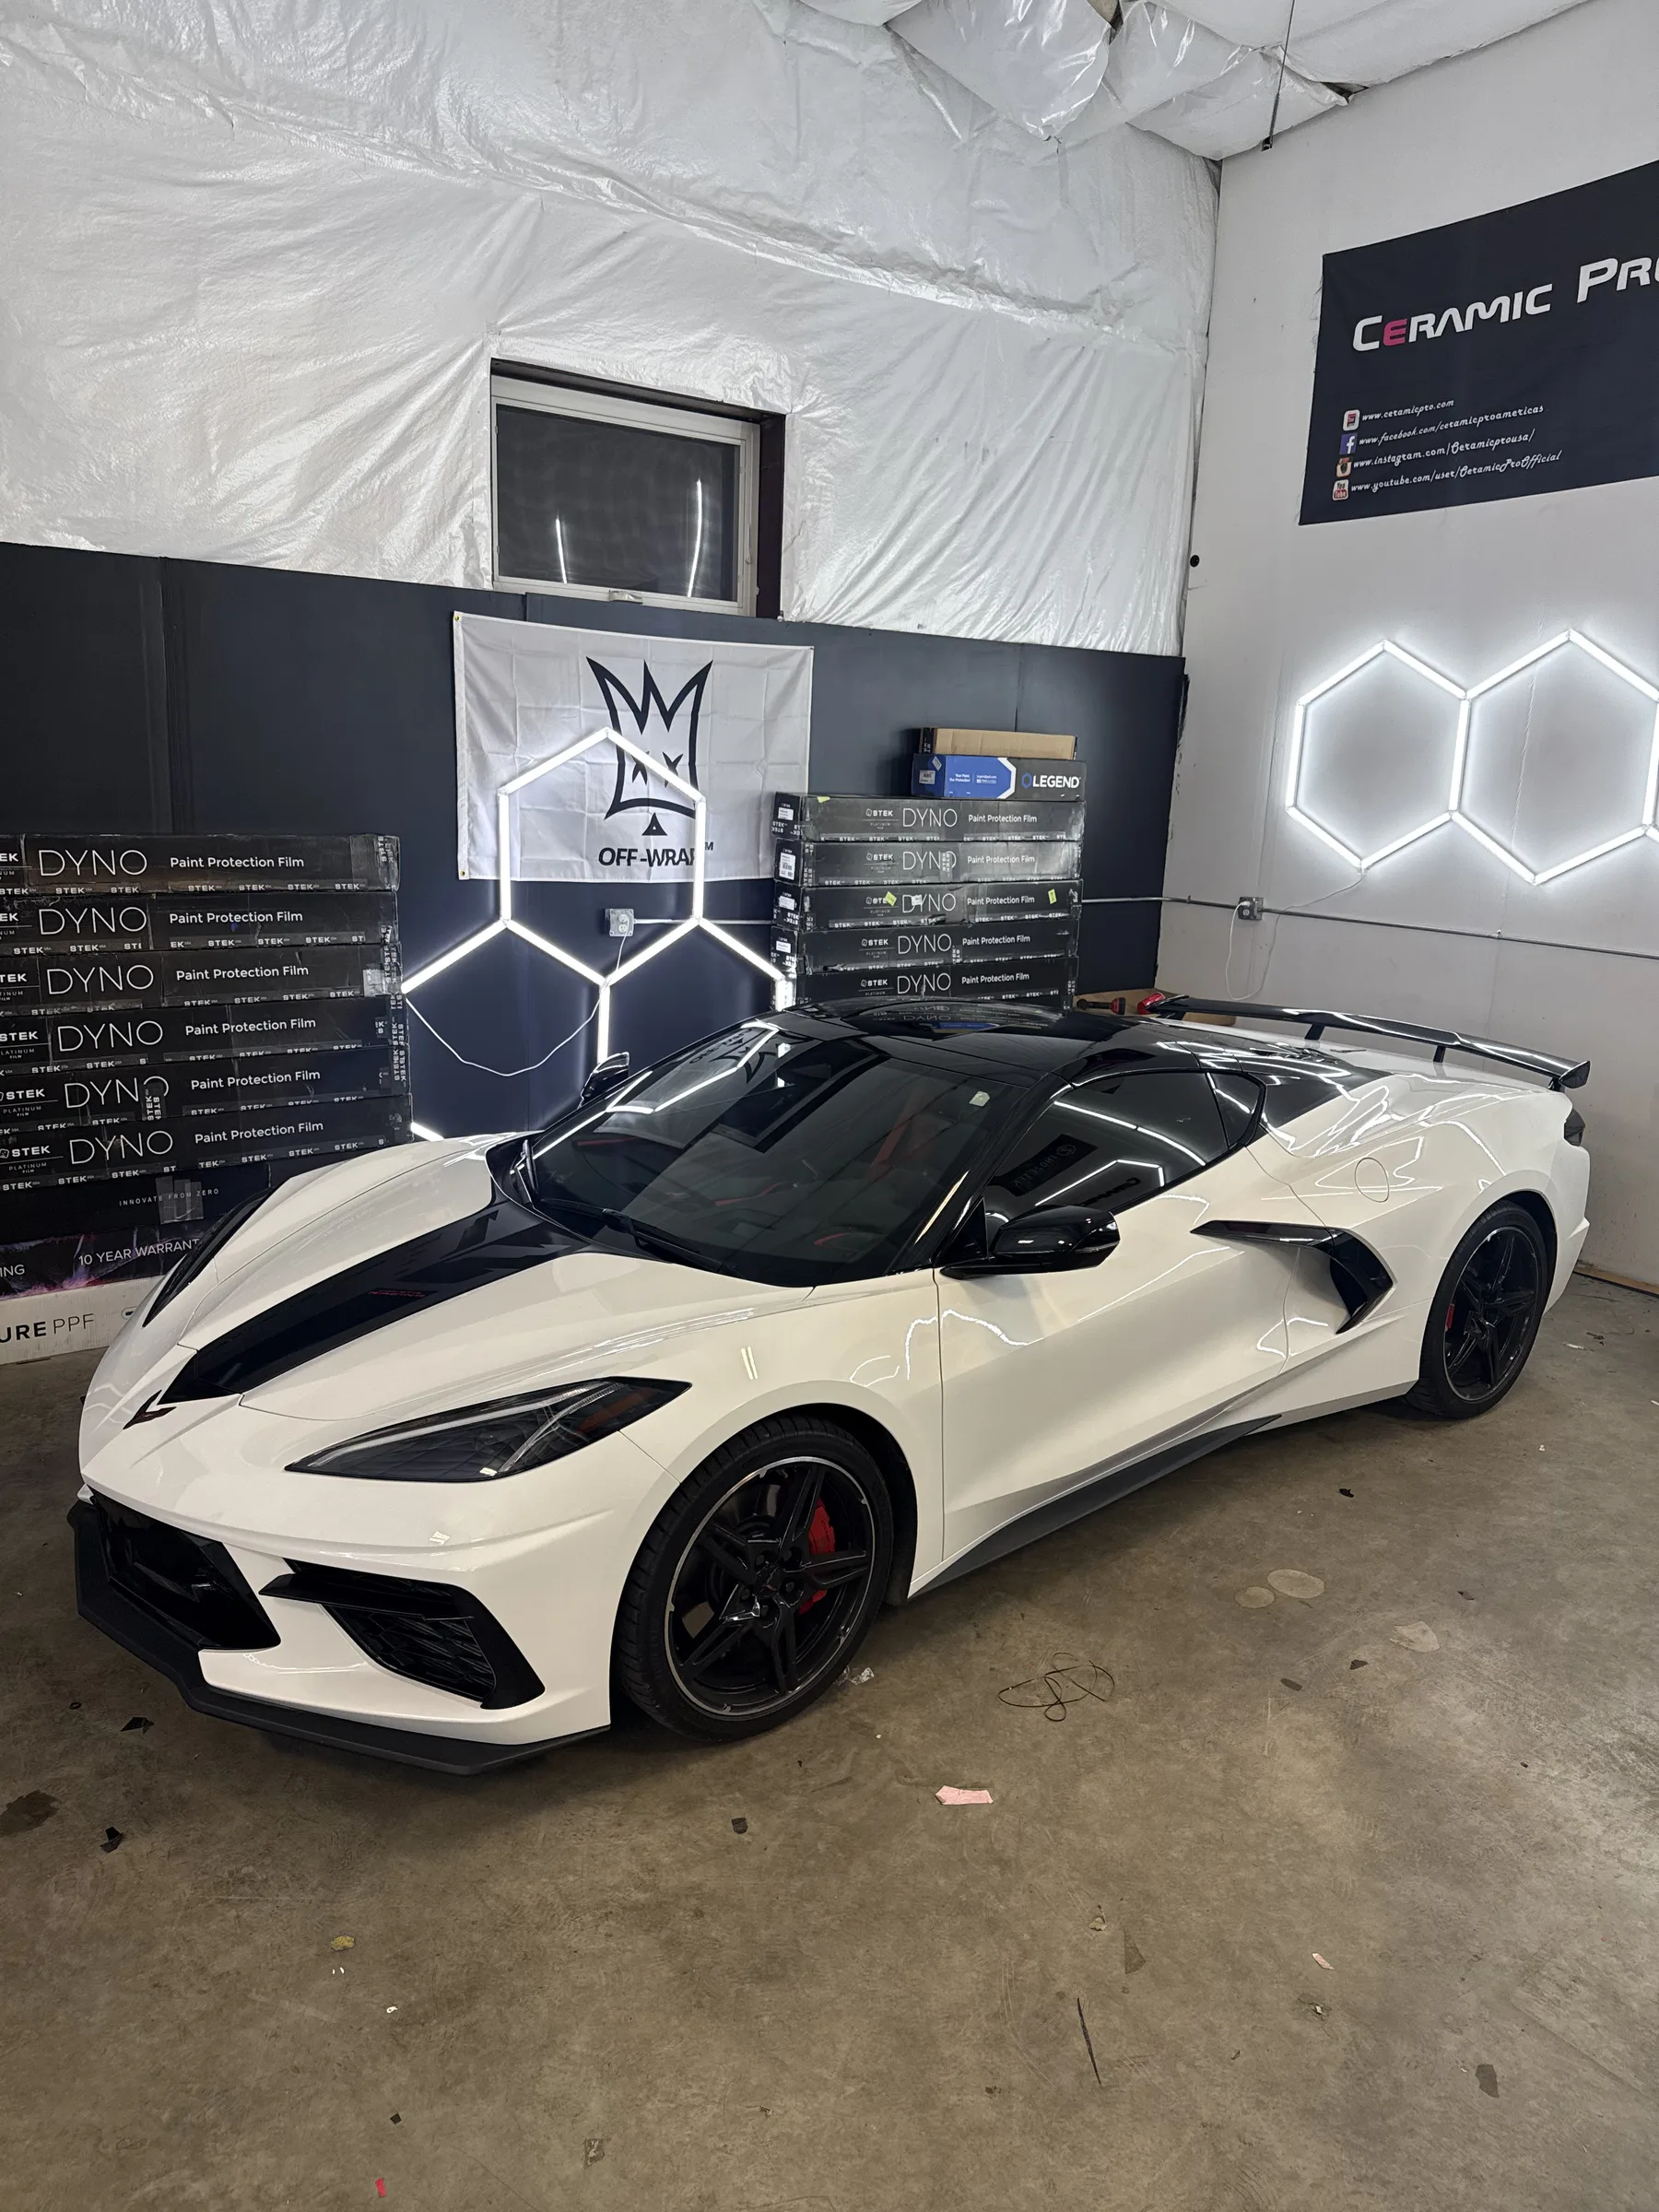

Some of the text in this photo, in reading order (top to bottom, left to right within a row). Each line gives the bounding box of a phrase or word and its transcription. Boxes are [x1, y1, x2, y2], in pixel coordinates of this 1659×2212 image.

[1352, 257, 1659, 352] CERAMIC PR
[1362, 400, 1454, 421] www.ceramicpro.com
[1359, 406, 1544, 446] www.facebook.com/ceramicproamericas
[873, 807, 1038, 828] STEK DYNO Paint Protection Film
[38, 849, 147, 877] DYNO
[170, 856, 204, 868] Paint
[207, 856, 275, 868] Protection
[278, 856, 304, 867] Film
[968, 854, 984, 865] Paint
[985, 855, 1019, 865] Protection
[1021, 854, 1035, 863] Film
[55, 887, 85, 895] STEK
[111, 886, 138, 894] STEK
[901, 892, 957, 913] DYNO
[967, 897, 984, 906] Paint
[985, 896, 1020, 906] Protection
[1021, 895, 1035, 904] Film
[38, 906, 147, 935] DYNO
[170, 912, 204, 924] Paint
[206, 912, 274, 924] Protection
[276, 911, 303, 922] Film
[13, 947, 43, 955] STEK
[867, 933, 1030, 955] STEK DYNO Paint Protection Film
[46, 964, 154, 994] DYNO
[176, 970, 210, 982] Paint
[213, 967, 279, 979] Protection
[283, 965, 309, 977] Film
[867, 972, 1030, 994] STEK DYNO Paint Protection Film
[329, 990, 354, 998] STEK
[0, 1018, 316, 1052] STEK DYNO Paint Protection Film
[31, 1061, 115, 1074] STEK STEK
[6, 1088, 45, 1100] STEK
[191, 1078, 224, 1090] Paint
[227, 1073, 292, 1087] Protection
[295, 1070, 321, 1081] Film
[12, 1122, 324, 1164] STEK DYNO Paint Protection Film
[241, 1154, 267, 1163] STEK
[288, 1148, 313, 1157] STEK
[335, 1142, 359, 1150] STEK
[8, 1162, 47, 1171] PLATINUM
[3, 1182, 32, 1191] STEK
[58, 1175, 87, 1184] STEK
[112, 1170, 139, 1178] STEK
[119, 1188, 219, 1206] INNOVATE FROM ZERO
[78, 1254, 92, 1265] 10
[96, 1249, 132, 1264] YEAR
[53, 1313, 94, 1335] PPF
